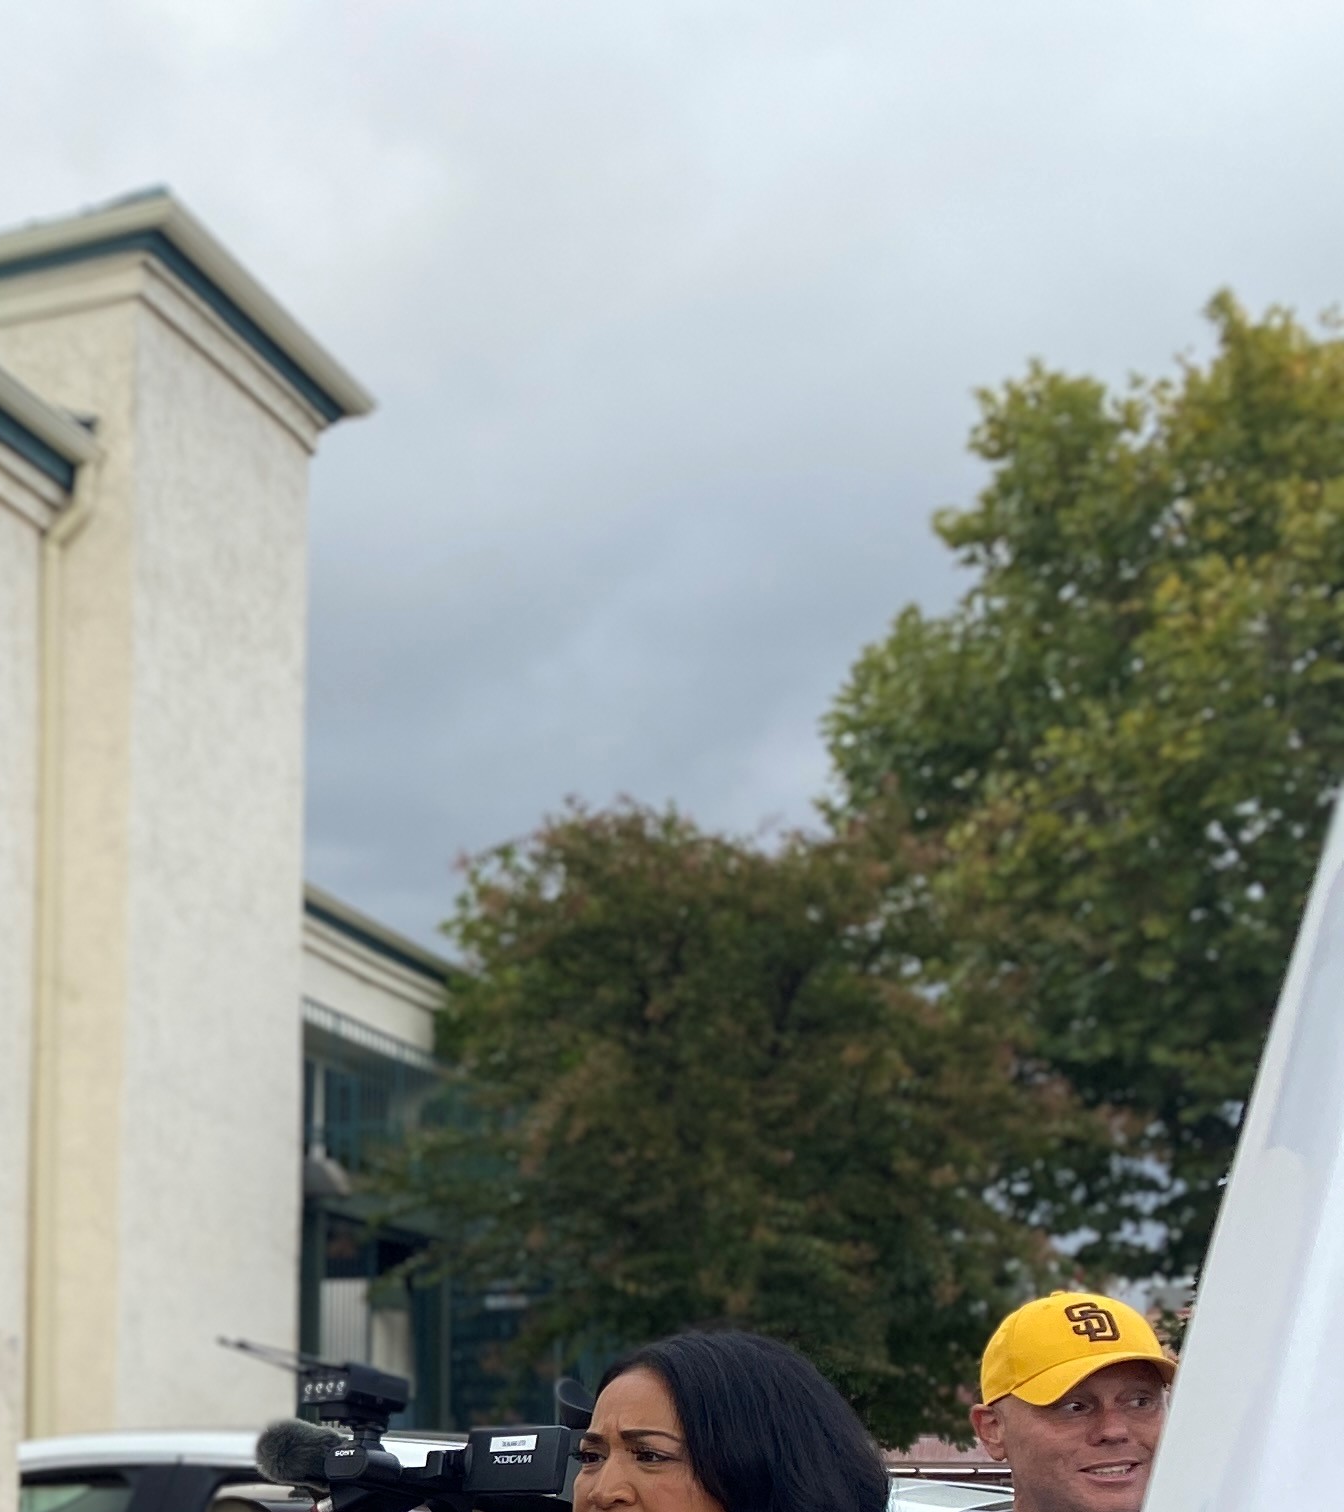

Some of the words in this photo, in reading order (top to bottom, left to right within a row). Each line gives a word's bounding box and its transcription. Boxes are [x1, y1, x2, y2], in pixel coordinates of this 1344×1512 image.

[1064, 1302, 1120, 1342] SD
[334, 1449, 355, 1458] SONY
[492, 1454, 533, 1465] XDCAM
